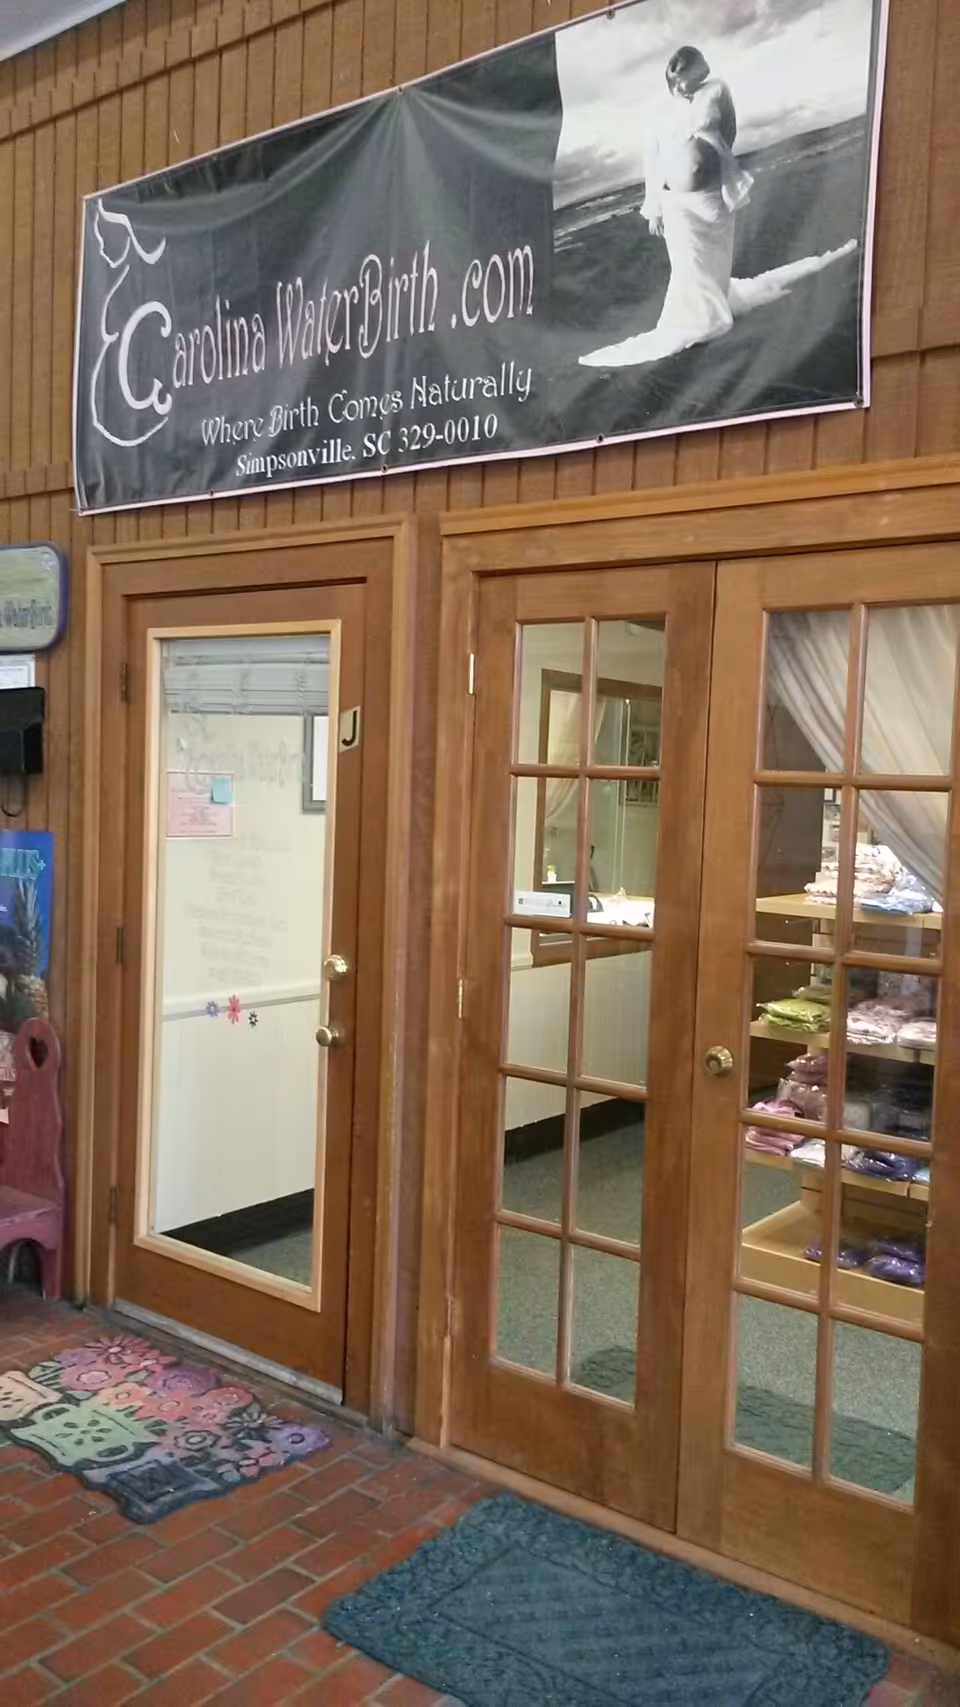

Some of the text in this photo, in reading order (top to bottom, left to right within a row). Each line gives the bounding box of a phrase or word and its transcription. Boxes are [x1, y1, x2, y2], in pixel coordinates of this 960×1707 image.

[117, 239, 534, 416] Carolina WaterBirth .com
[201, 360, 532, 446] Where Birth Comes Naturally
[363, 430, 392, 458] SC
[398, 413, 498, 453] 329-0010
[341, 709, 358, 747] J
